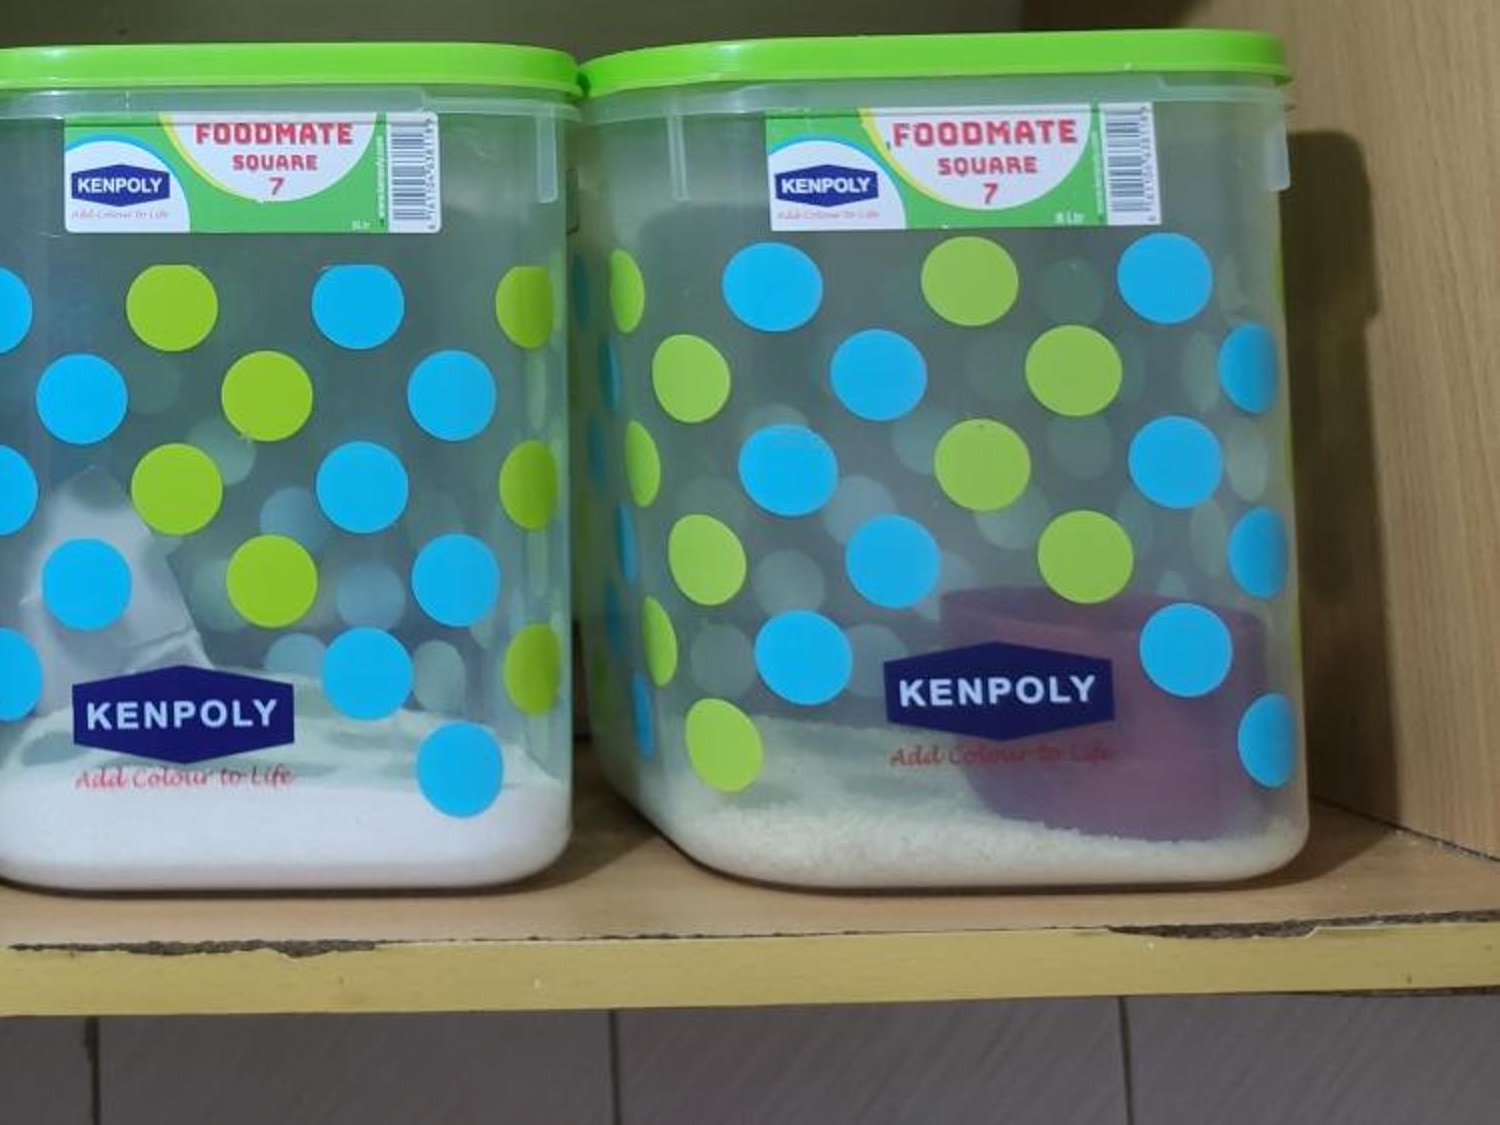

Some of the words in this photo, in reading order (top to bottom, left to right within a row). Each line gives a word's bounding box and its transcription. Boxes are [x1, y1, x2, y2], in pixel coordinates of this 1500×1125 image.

[195, 122, 353, 146] FOODMATE
[893, 119, 1078, 148] FOODMATE
[232, 154, 319, 174] SQUARE
[938, 155, 1038, 177] SQUARE
[77, 177, 163, 195] KENPOLY
[269, 177, 284, 197] 7
[780, 177, 871, 195] KENPOLY
[983, 182, 999, 205] 7
[900, 675, 1095, 708] KENPOLY
[86, 699, 278, 731] KENPOLY
[74, 767, 127, 789] Add
[133, 765, 209, 787] Colour
[220, 767, 244, 786] to
[250, 762, 294, 788] Life
